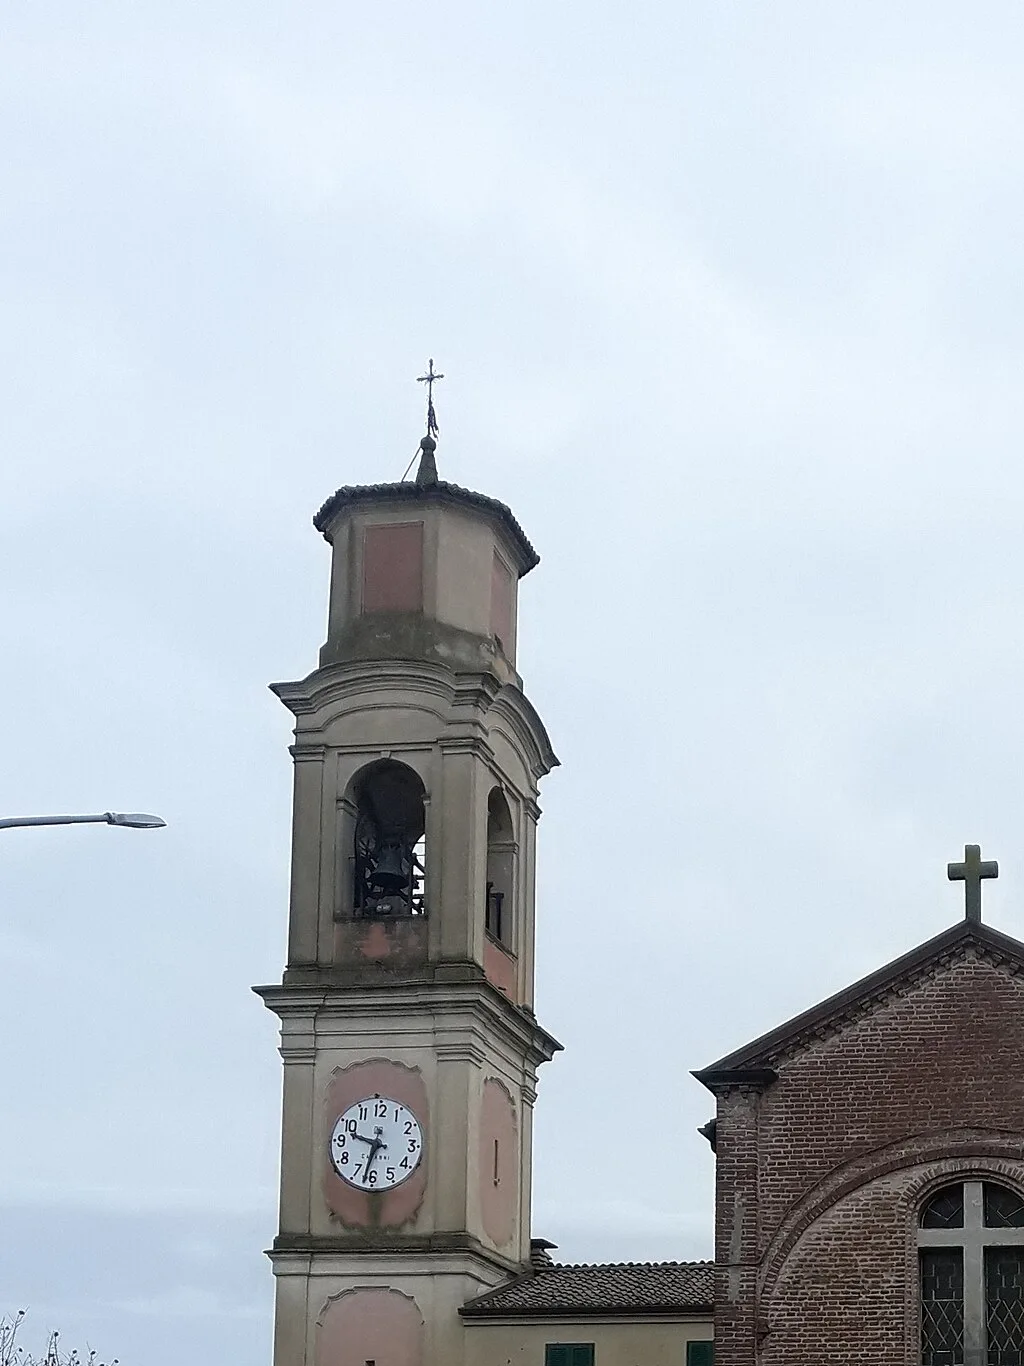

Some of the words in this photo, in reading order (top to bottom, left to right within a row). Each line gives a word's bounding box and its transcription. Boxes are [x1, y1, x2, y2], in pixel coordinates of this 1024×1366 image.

[359, 1107, 368, 1120] 11
[374, 1104, 387, 1117] 12
[394, 1109, 399, 1122] 1
[345, 1119, 357, 1132] 10
[403, 1121, 412, 1134] 2
[337, 1134, 346, 1147] 9
[407, 1139, 416, 1153] 3
[340, 1151, 349, 1164] 8
[399, 1156, 408, 1169] 4
[353, 1163, 362, 1176] 7
[386, 1167, 395, 1180] 5
[368, 1170, 377, 1183] 6
